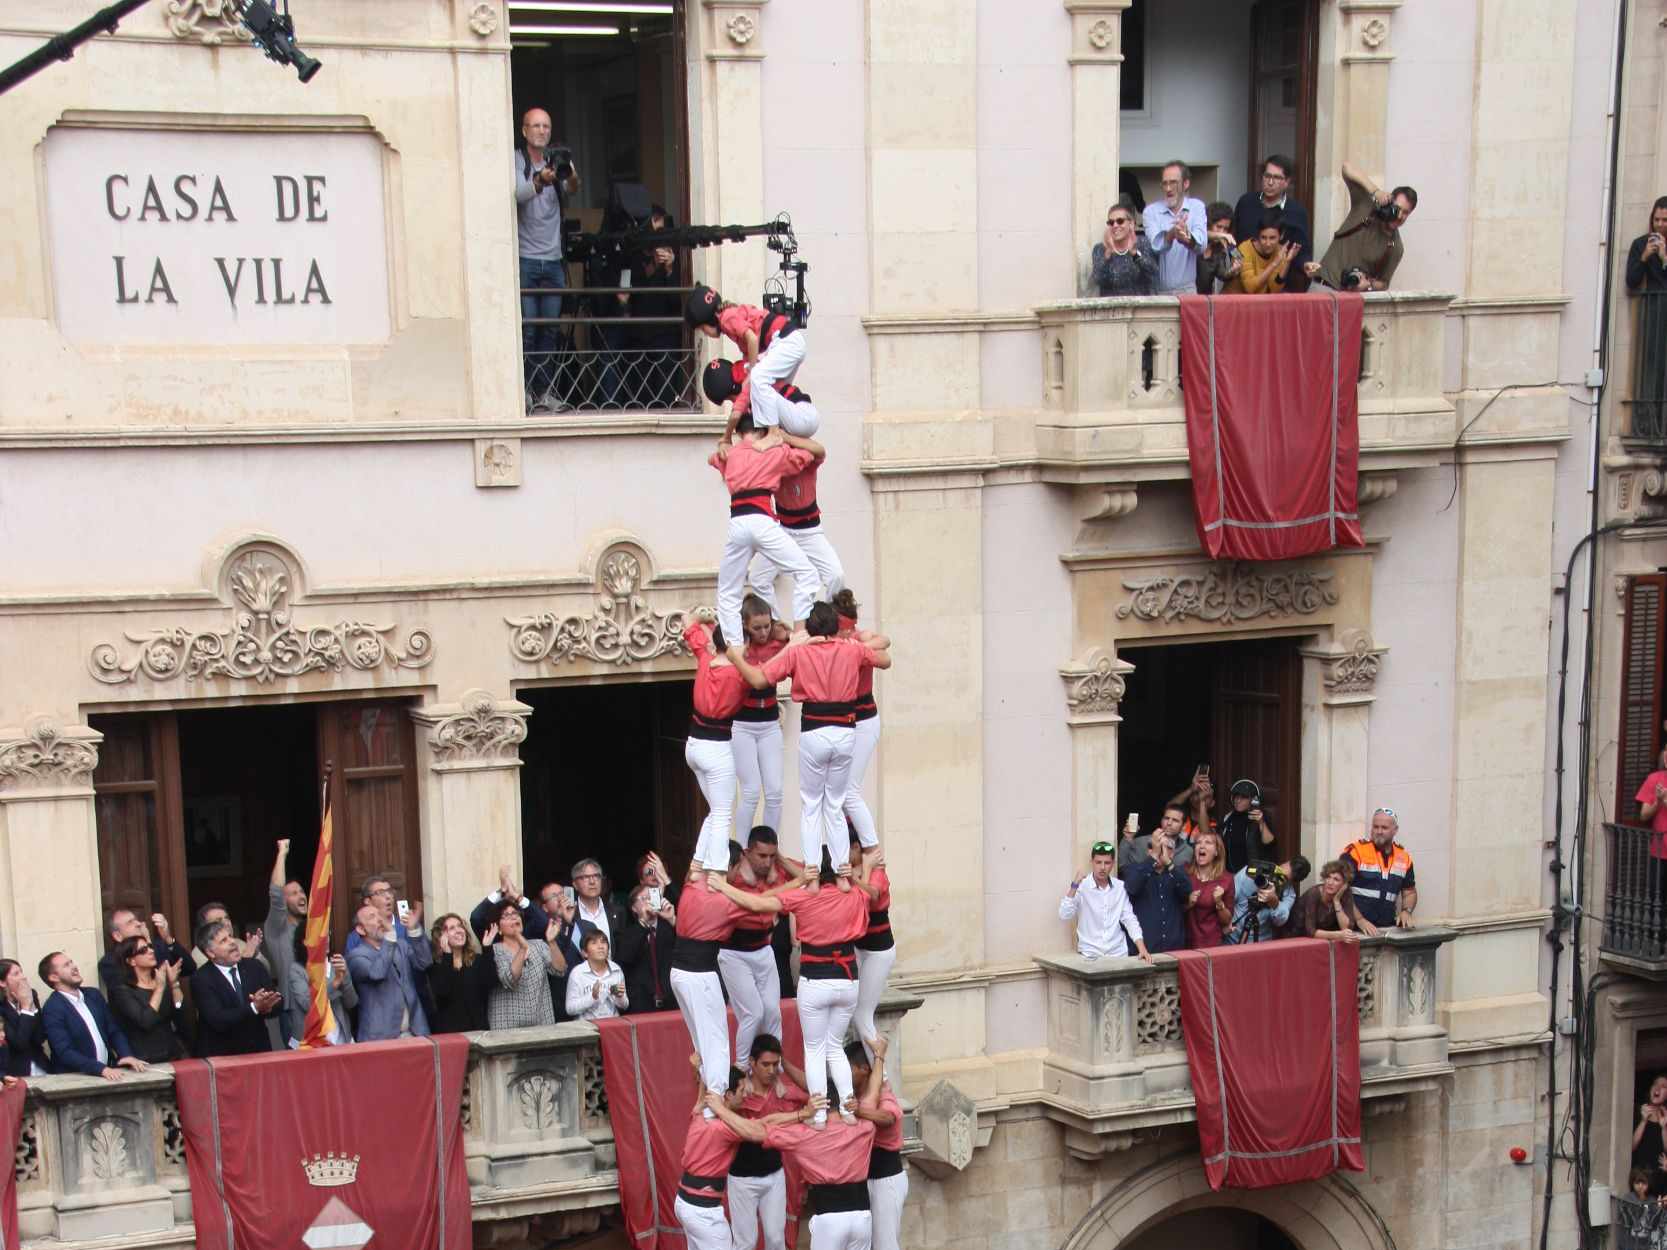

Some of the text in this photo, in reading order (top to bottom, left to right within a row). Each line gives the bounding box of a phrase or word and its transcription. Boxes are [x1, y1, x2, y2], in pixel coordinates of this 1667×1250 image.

[105, 174, 328, 222] CASA DE
[112, 256, 333, 306] LA VILA
